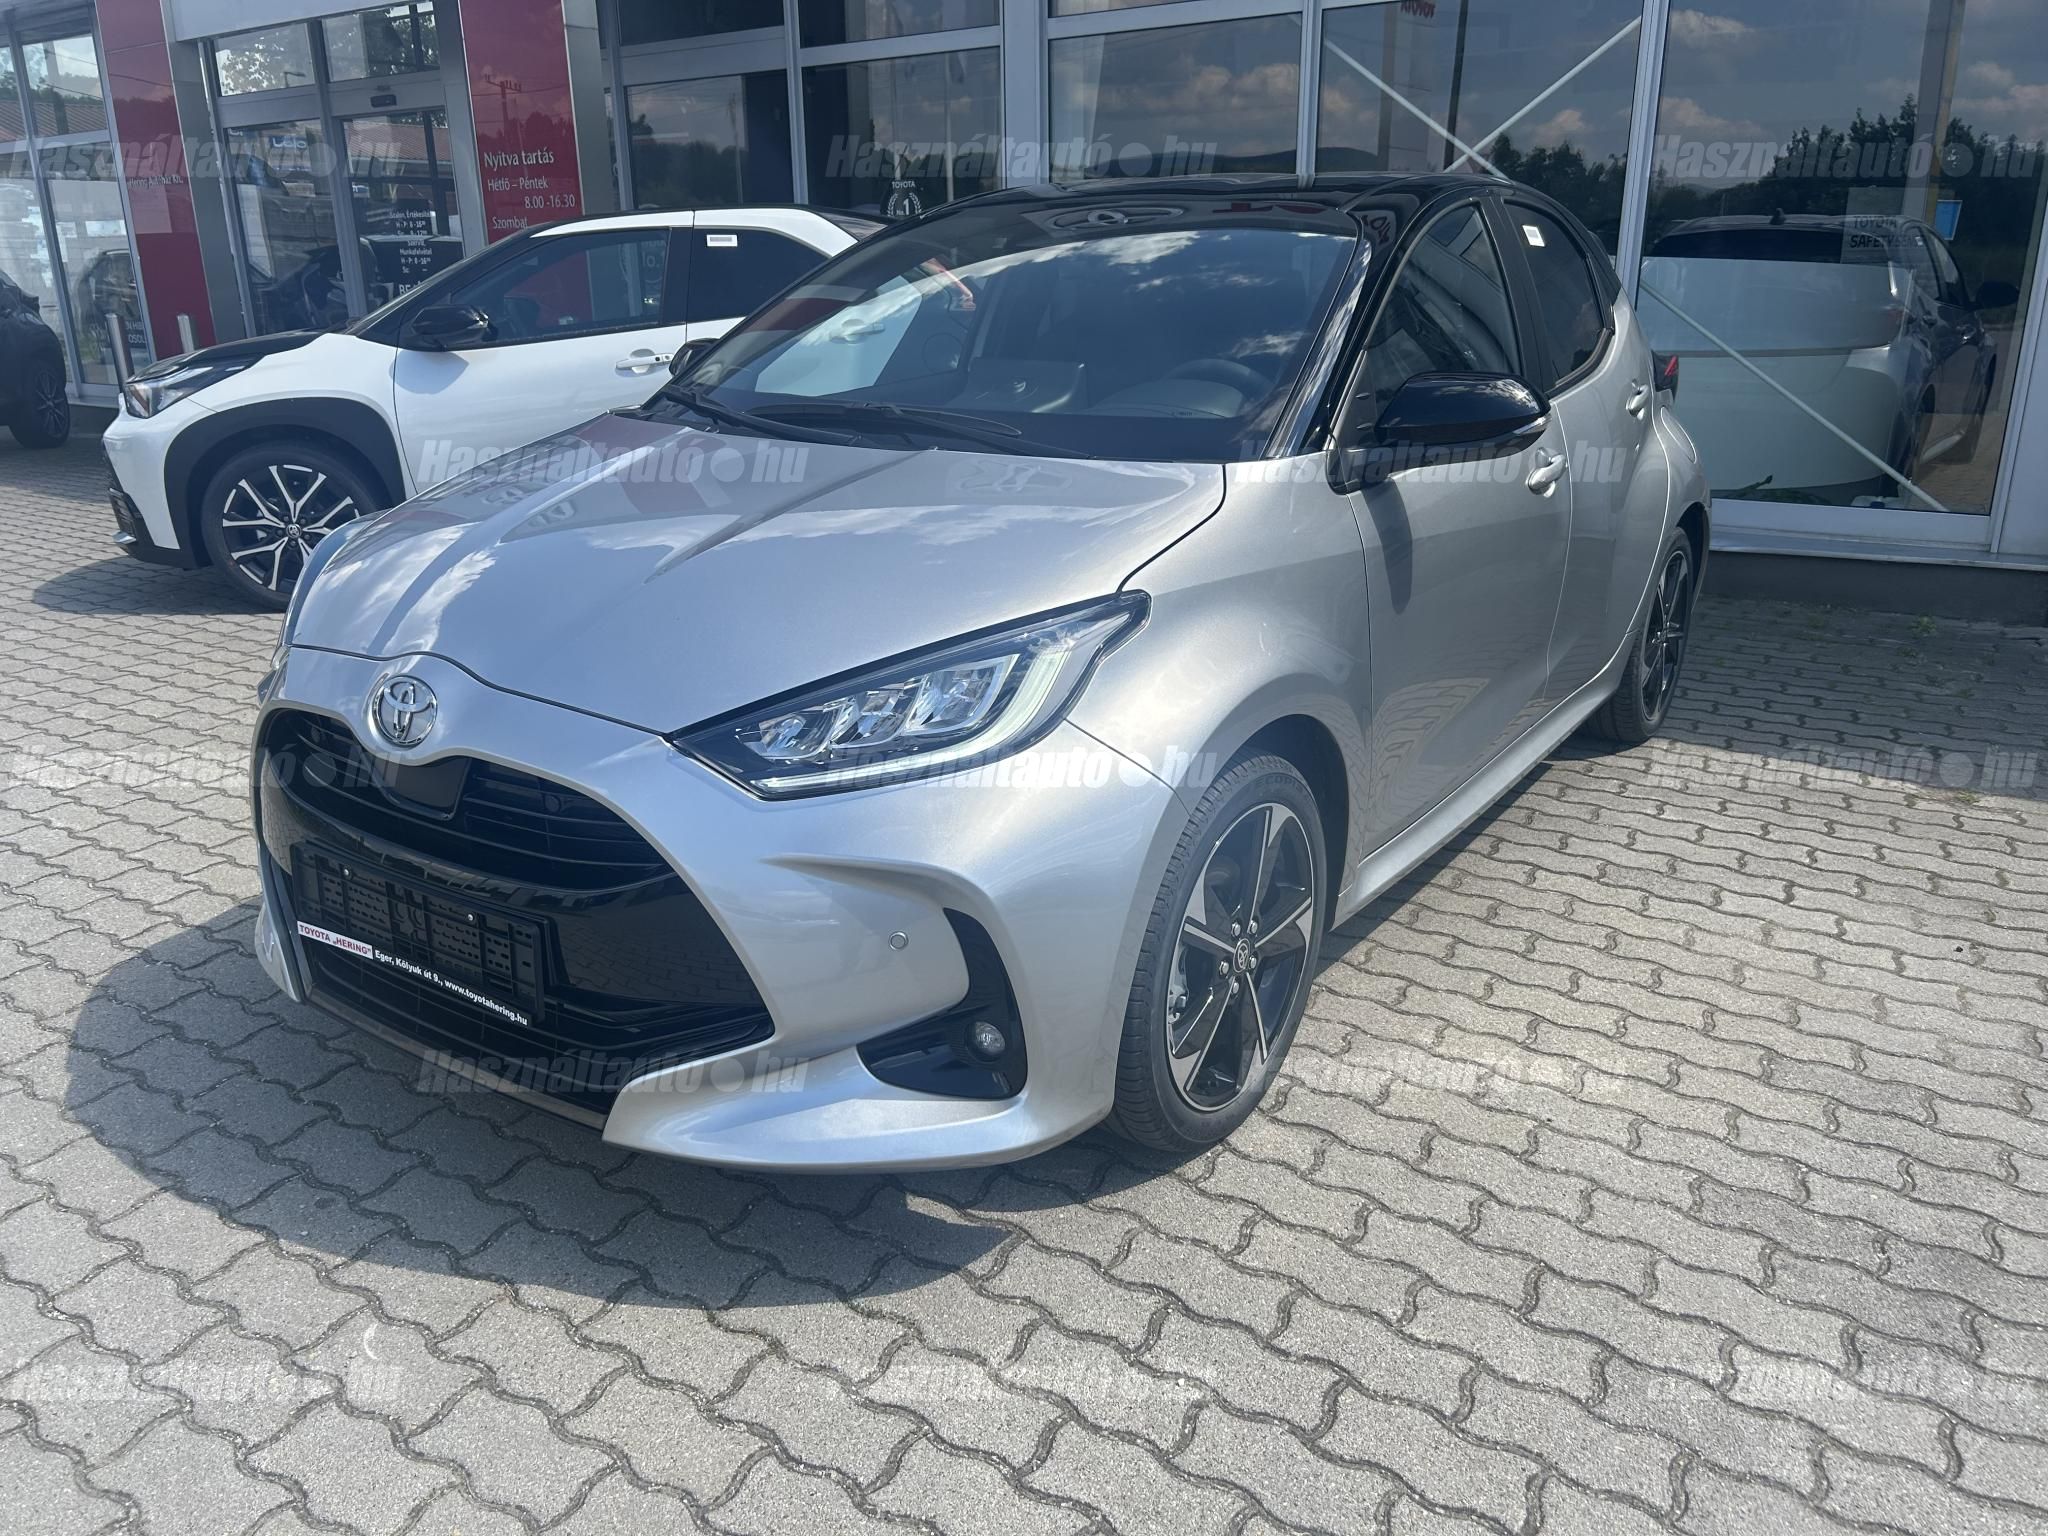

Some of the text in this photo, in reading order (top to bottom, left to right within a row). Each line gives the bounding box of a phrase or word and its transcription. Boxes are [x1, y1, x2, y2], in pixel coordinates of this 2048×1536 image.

[484, 147, 554, 171] Nyitva tartás
[520, 176, 549, 190] Péntek
[892, 180, 916, 188] TOYOTA
[524, 196, 544, 209] 8.00
[299, 925, 330, 942] TOYOTA
[375, 950, 394, 965] Eger,
[445, 980, 527, 1025] www.toyotahering.hu
